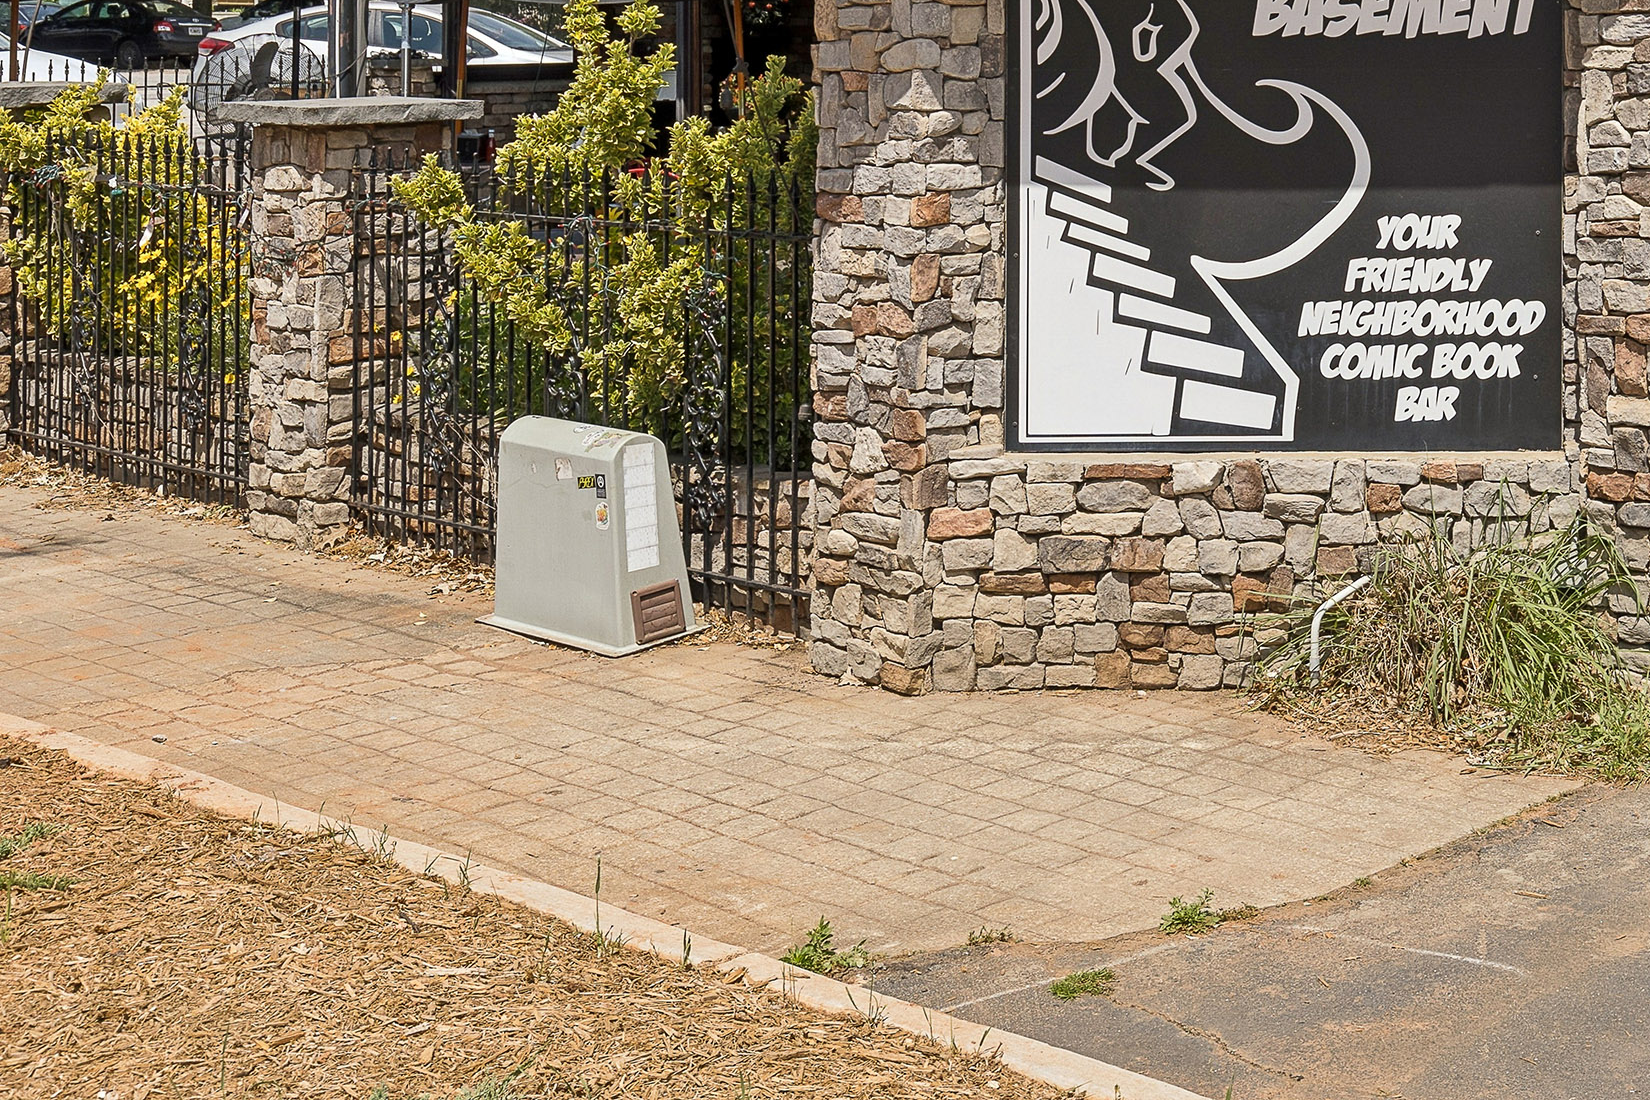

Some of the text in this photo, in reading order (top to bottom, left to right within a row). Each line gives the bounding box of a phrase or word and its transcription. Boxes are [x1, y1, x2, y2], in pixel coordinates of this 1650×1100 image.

[1376, 213, 1461, 250] YOUR
[1344, 257, 1493, 294] FRIENDLY
[1298, 299, 1546, 337] NEIGHBORHOOD
[1319, 342, 1524, 380] COMIC BOOK
[1394, 386, 1460, 422] BAR
